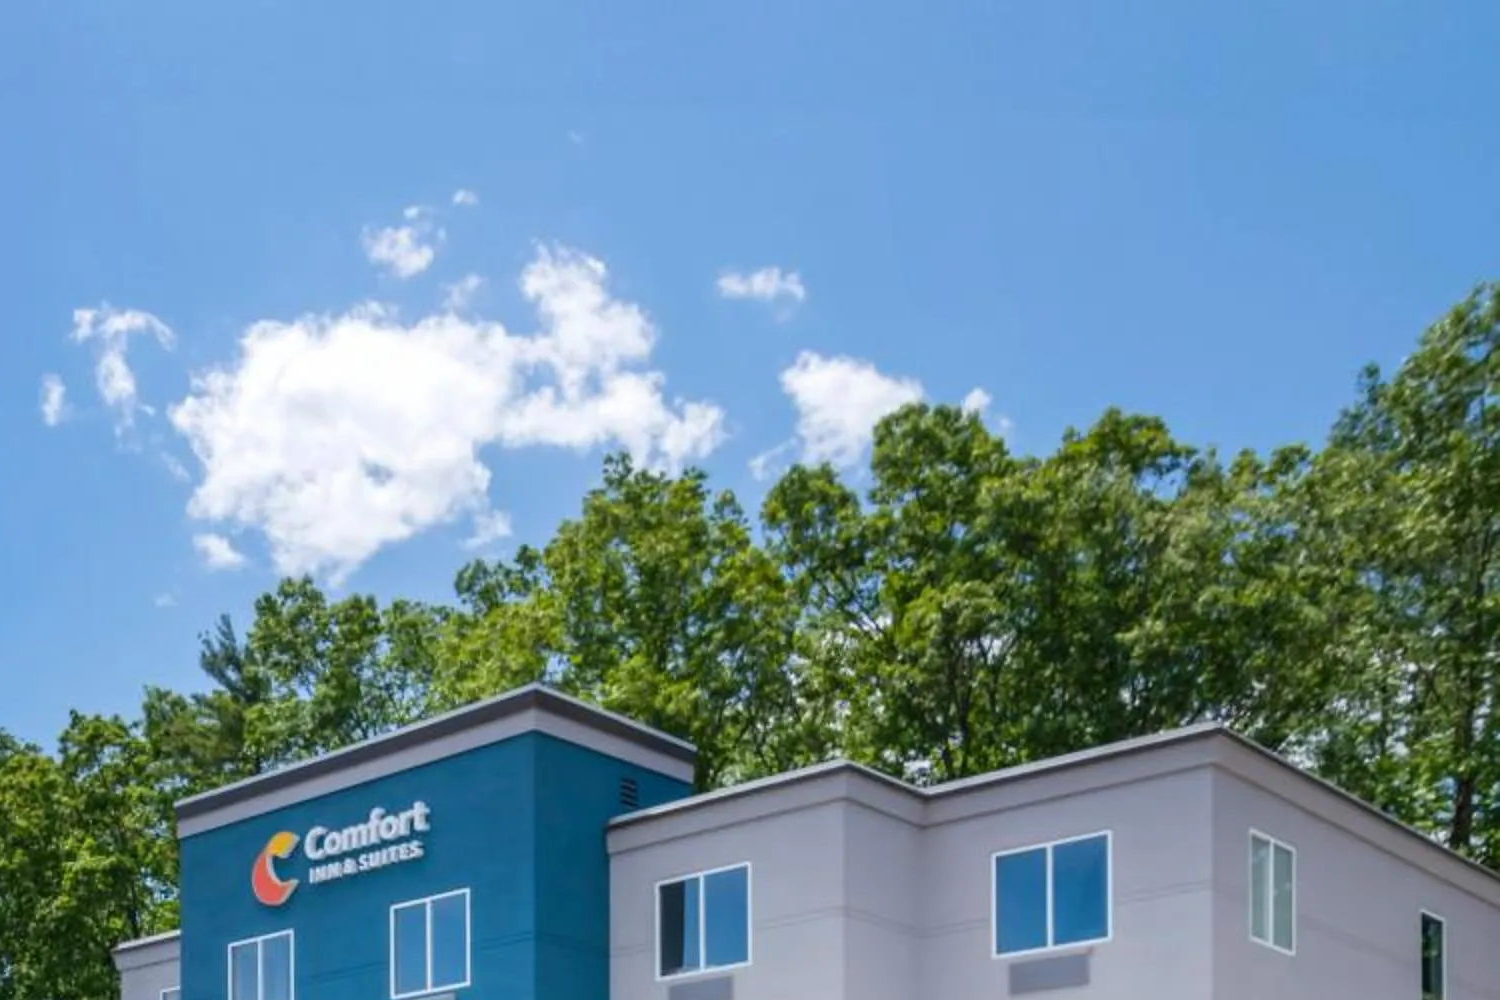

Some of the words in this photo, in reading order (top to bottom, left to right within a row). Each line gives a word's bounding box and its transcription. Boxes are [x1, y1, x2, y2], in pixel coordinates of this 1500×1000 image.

[304, 801, 430, 860] Comfort
[309, 862, 343, 884] INN
[343, 858, 358, 874] &
[357, 840, 424, 871] SUITES
